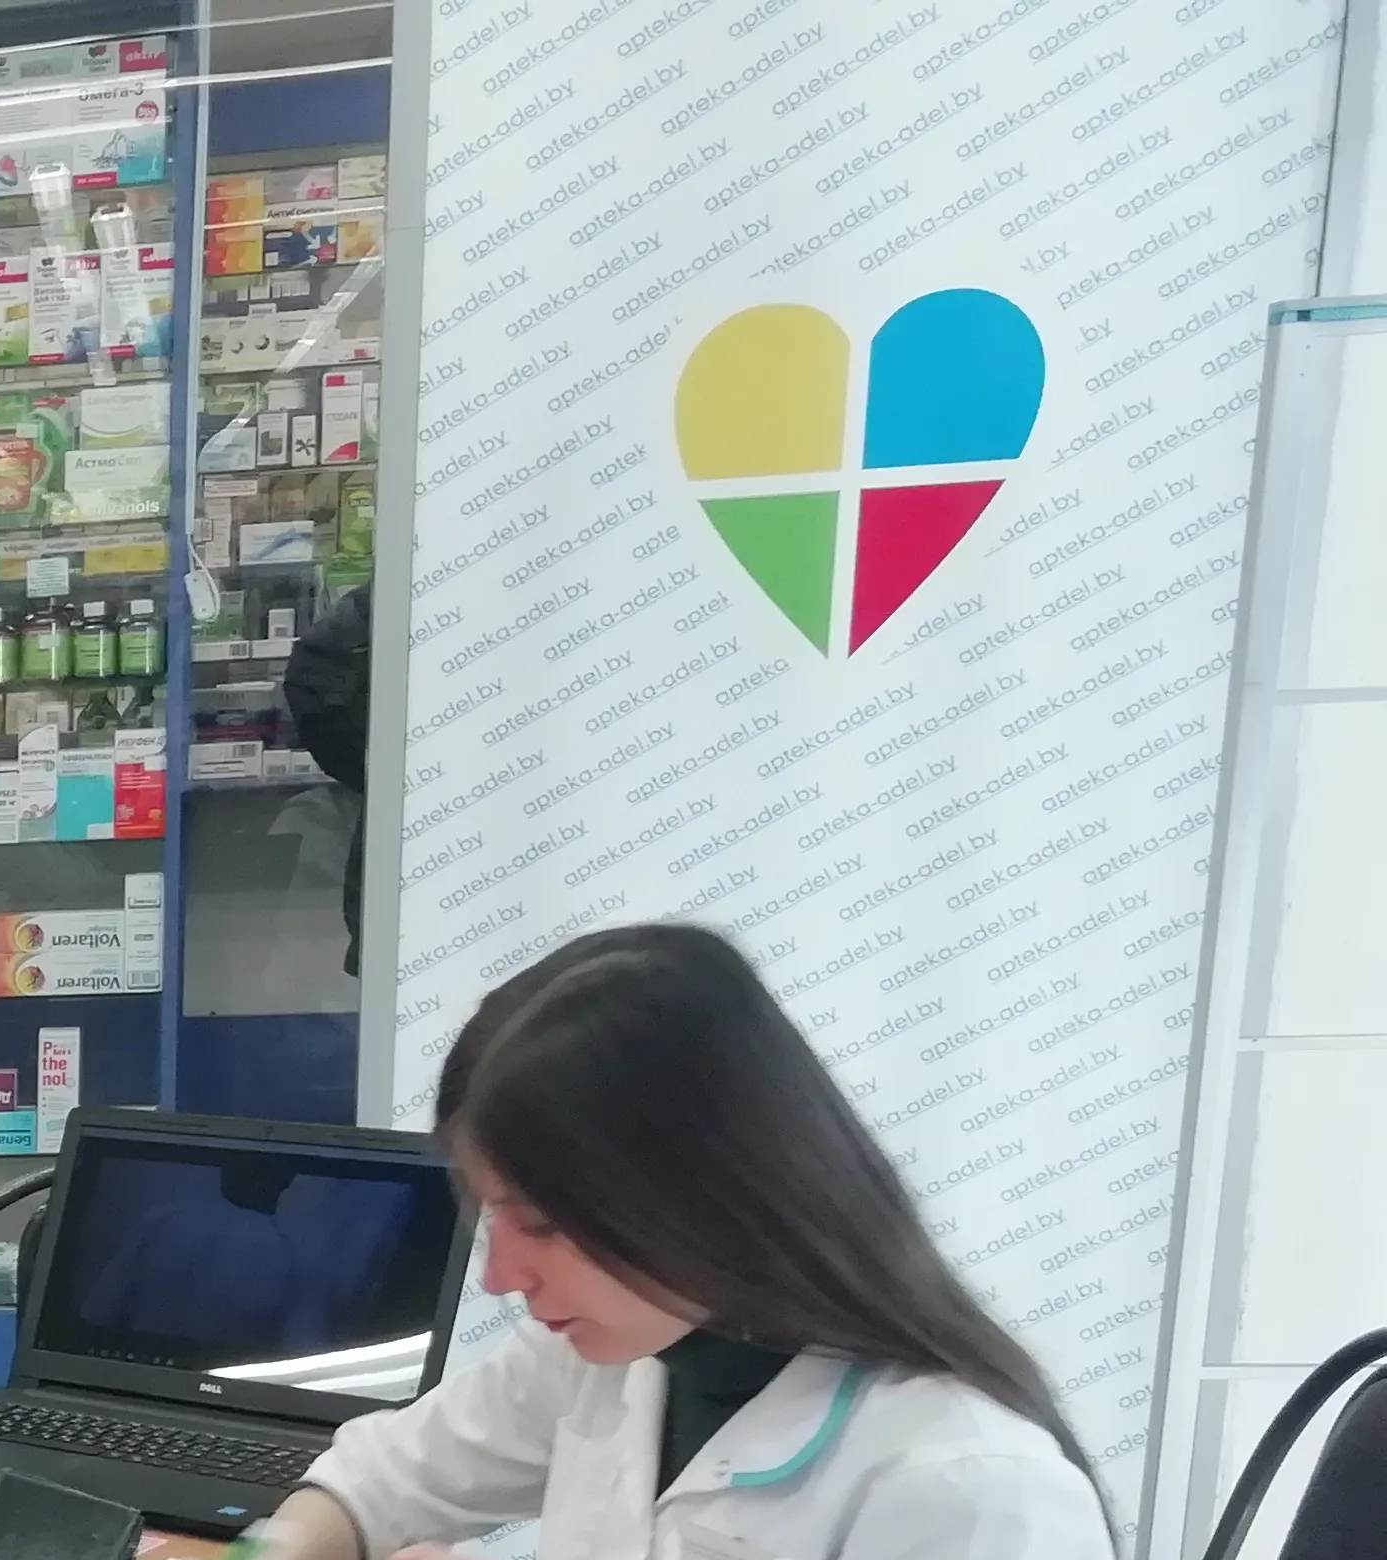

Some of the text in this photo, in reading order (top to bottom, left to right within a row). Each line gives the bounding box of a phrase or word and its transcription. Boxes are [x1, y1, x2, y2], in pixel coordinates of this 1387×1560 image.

[661, 22, 823, 138] apteka-adel.by
[772, 3, 939, 119] apteka-adel.by
[956, 46, 1130, 162] apteka-adel.by
[1072, 26, 1248, 142] apteka-adel.by
[526, 59, 687, 173] apteka-adel.by
[704, 101, 870, 215] apteka-adel.by
[816, 83, 984, 197] apteka-adel.by
[1115, 108, 1293, 221] apteka-adel.by
[463, 156, 619, 265] apteka-adel.by
[569, 137, 731, 248] apteka-adel.by
[859, 162, 1027, 274] apteka-adel.by
[1000, 126, 1173, 241] apteka-adel.by
[505, 232, 662, 341] apteka-adel.by
[612, 214, 772, 324] apteka-adel.by
[1085, 285, 1258, 395] apteka-adel.by
[417, 341, 571, 443] apteka-adel.by
[460, 415, 616, 519] apteka-adel.by
[502, 490, 657, 591] apteka-adel.by
[1029, 474, 1198, 579] apteka-adel.by
[441, 578, 593, 677] apteka-adel.by
[544, 563, 700, 663] apteka-adel.by
[959, 564, 1127, 667] apteka-adel.by
[1070, 551, 1239, 654] apteka-adel.by
[482, 650, 635, 747] apteka-adel.by
[586, 636, 741, 736] apteka-adel.by
[757, 682, 917, 780] apteka-adel.by
[864, 668, 1027, 768] apteka-adel.by
[1000, 640, 1169, 741] apteka-adel.by
[400, 748, 547, 845] apteka-adel.by
[523, 722, 675, 818] apteka-adel.by
[626, 710, 783, 807] apteka-adel.by
[798, 755, 956, 853] apteka-adel.by
[906, 743, 1069, 840] apteka-adel.by
[1042, 715, 1208, 813] apteka-adel.by
[439, 819, 589, 912] apteka-adel.by
[564, 794, 717, 888] apteka-adel.by
[667, 782, 823, 877] apteka-adel.by
[839, 828, 999, 923] apteka-adel.by
[947, 816, 1110, 912] apteka-adel.by
[52, 932, 121, 948] Voltaren
[57, 975, 121, 990] Voltaren
[480, 890, 628, 981] apteka-adel.by
[880, 901, 1040, 994] apteka-adel.by
[987, 890, 1150, 984] apteka-adel.by
[920, 973, 1080, 1064] apteka-adel.by
[1028, 962, 1192, 1053] apteka-adel.by
[42, 1057, 67, 1071] the
[42, 1072, 67, 1087] nol
[960, 1044, 1123, 1134] apteka-adel.by
[1000, 1116, 1161, 1204] apteka-adel.by
[1040, 1194, 1175, 1275] apteka-adel.
[199, 1382, 222, 1394] DELL
